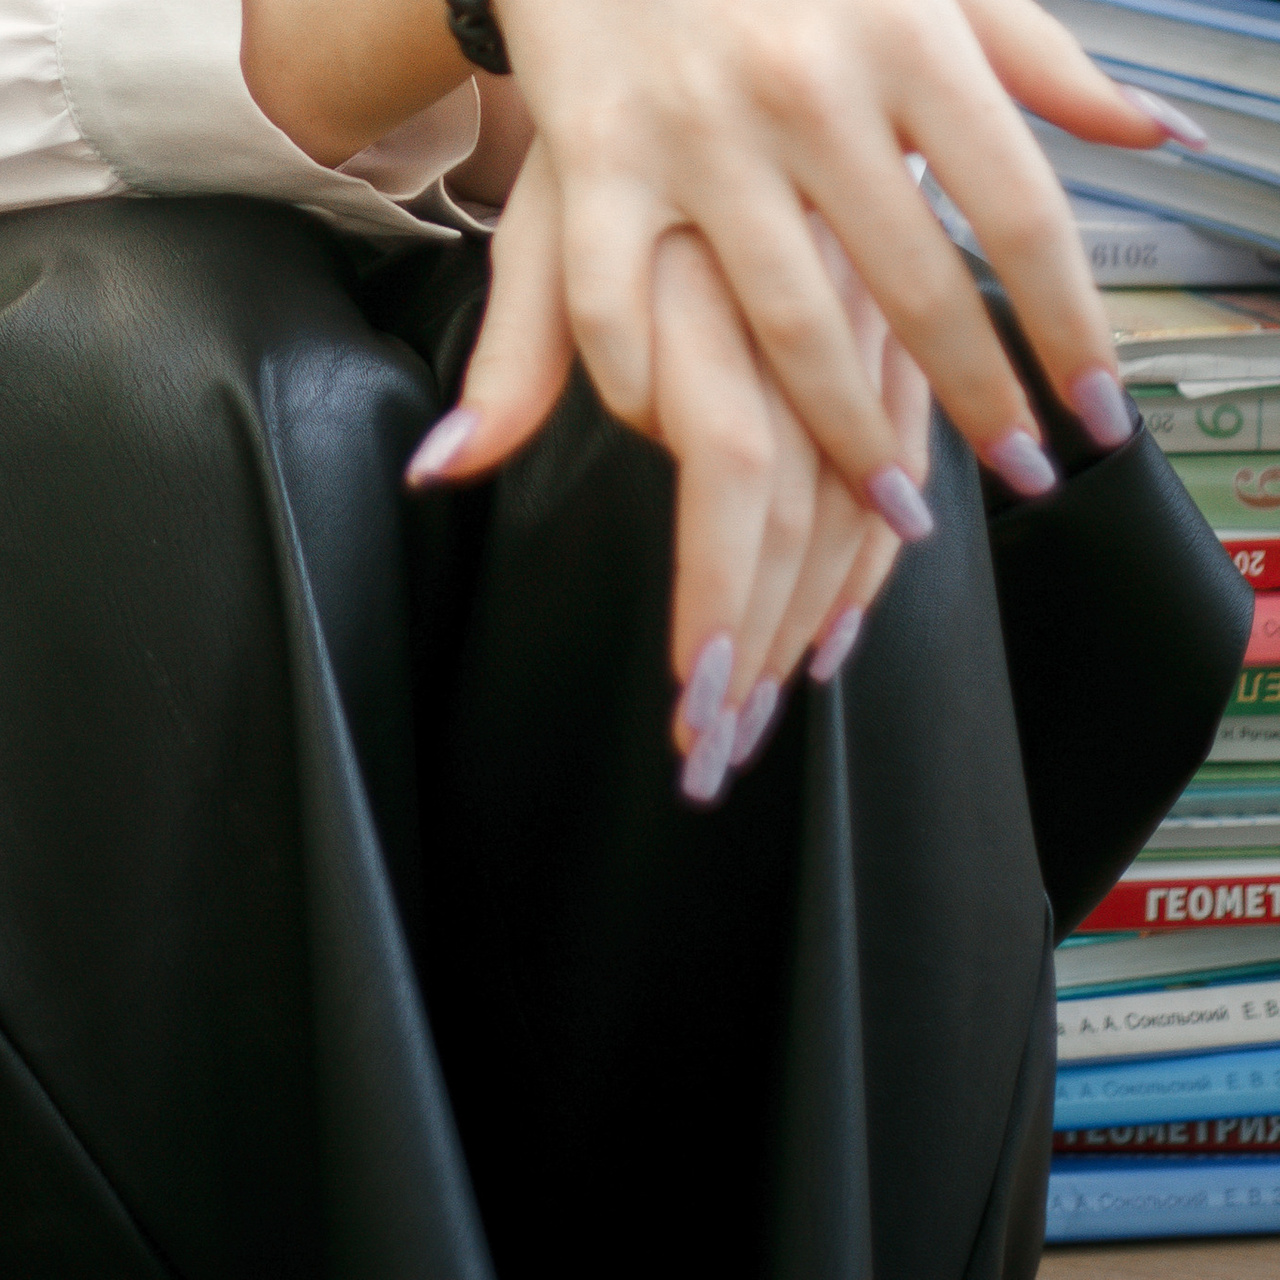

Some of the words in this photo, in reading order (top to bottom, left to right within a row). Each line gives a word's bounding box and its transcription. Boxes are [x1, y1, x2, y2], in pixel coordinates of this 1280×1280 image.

[1233, 550, 1266, 577] 20
[1145, 883, 1280, 922] ГЕОМЕТ
[1124, 1004, 1229, 1030] Сокольский
